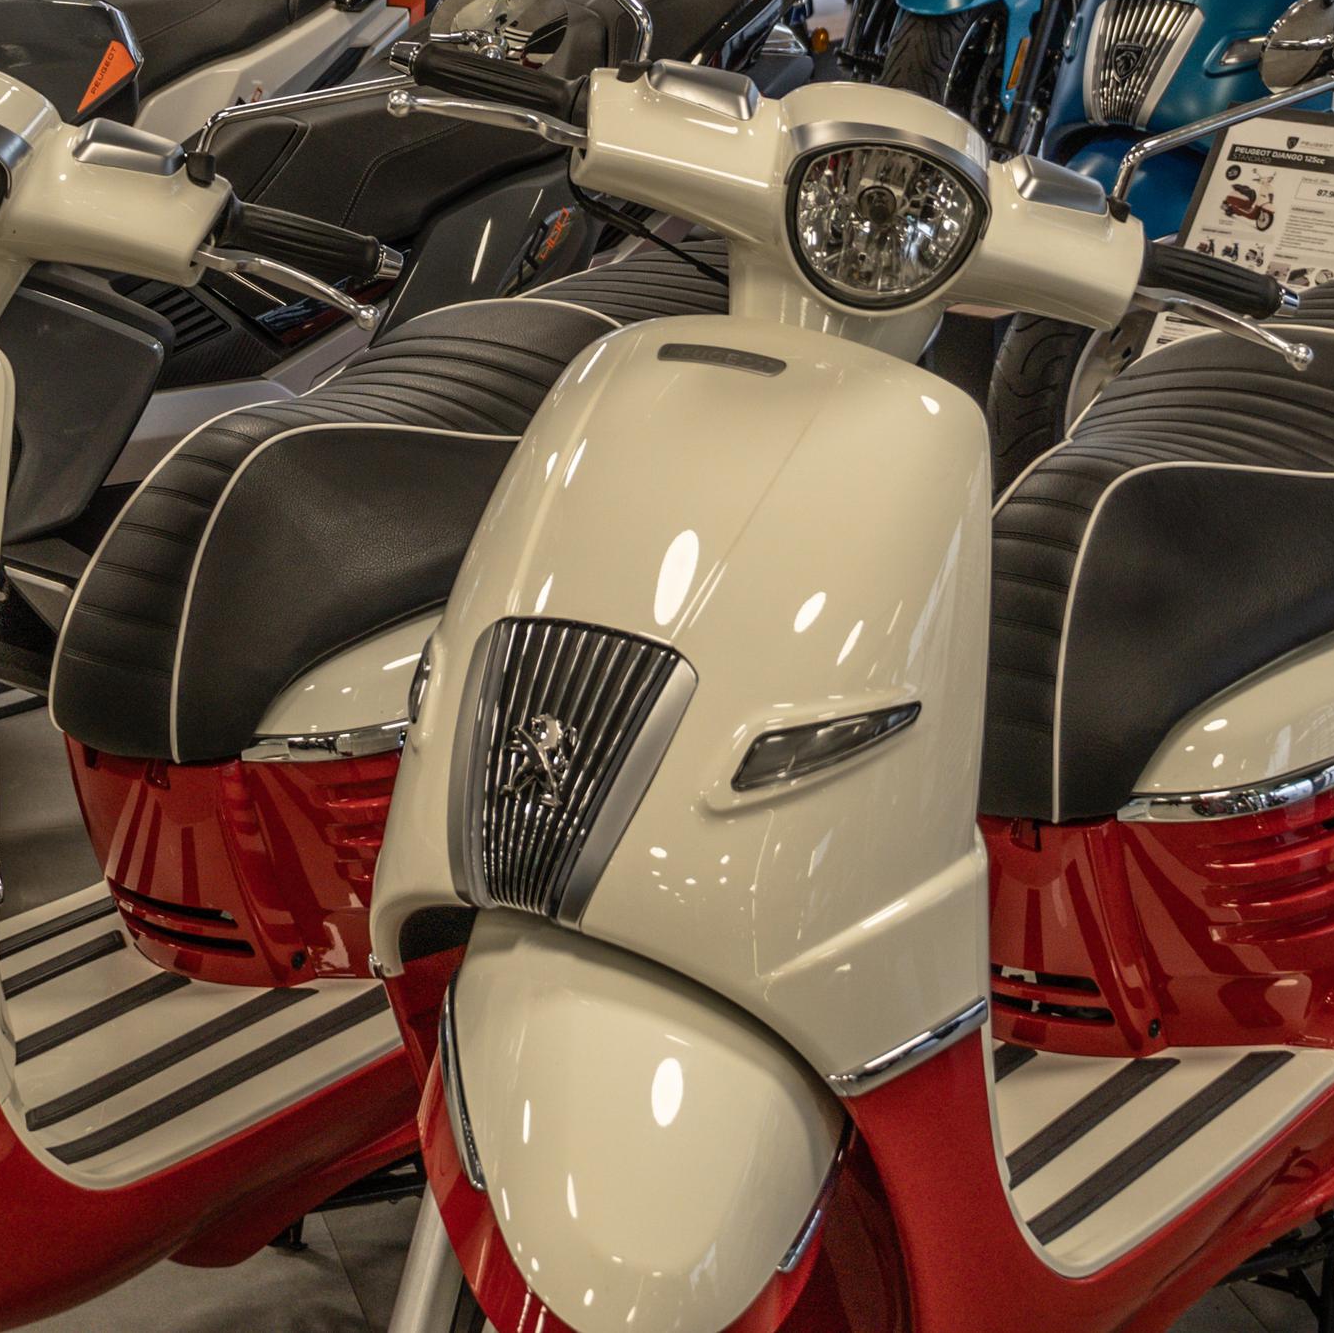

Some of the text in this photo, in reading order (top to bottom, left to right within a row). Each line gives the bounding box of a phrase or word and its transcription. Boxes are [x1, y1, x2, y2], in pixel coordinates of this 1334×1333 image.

[90, 46, 117, 96] PEUGEOT
[1234, 146, 1272, 158] PEUGEOT
[1272, 151, 1304, 162] DJANGO
